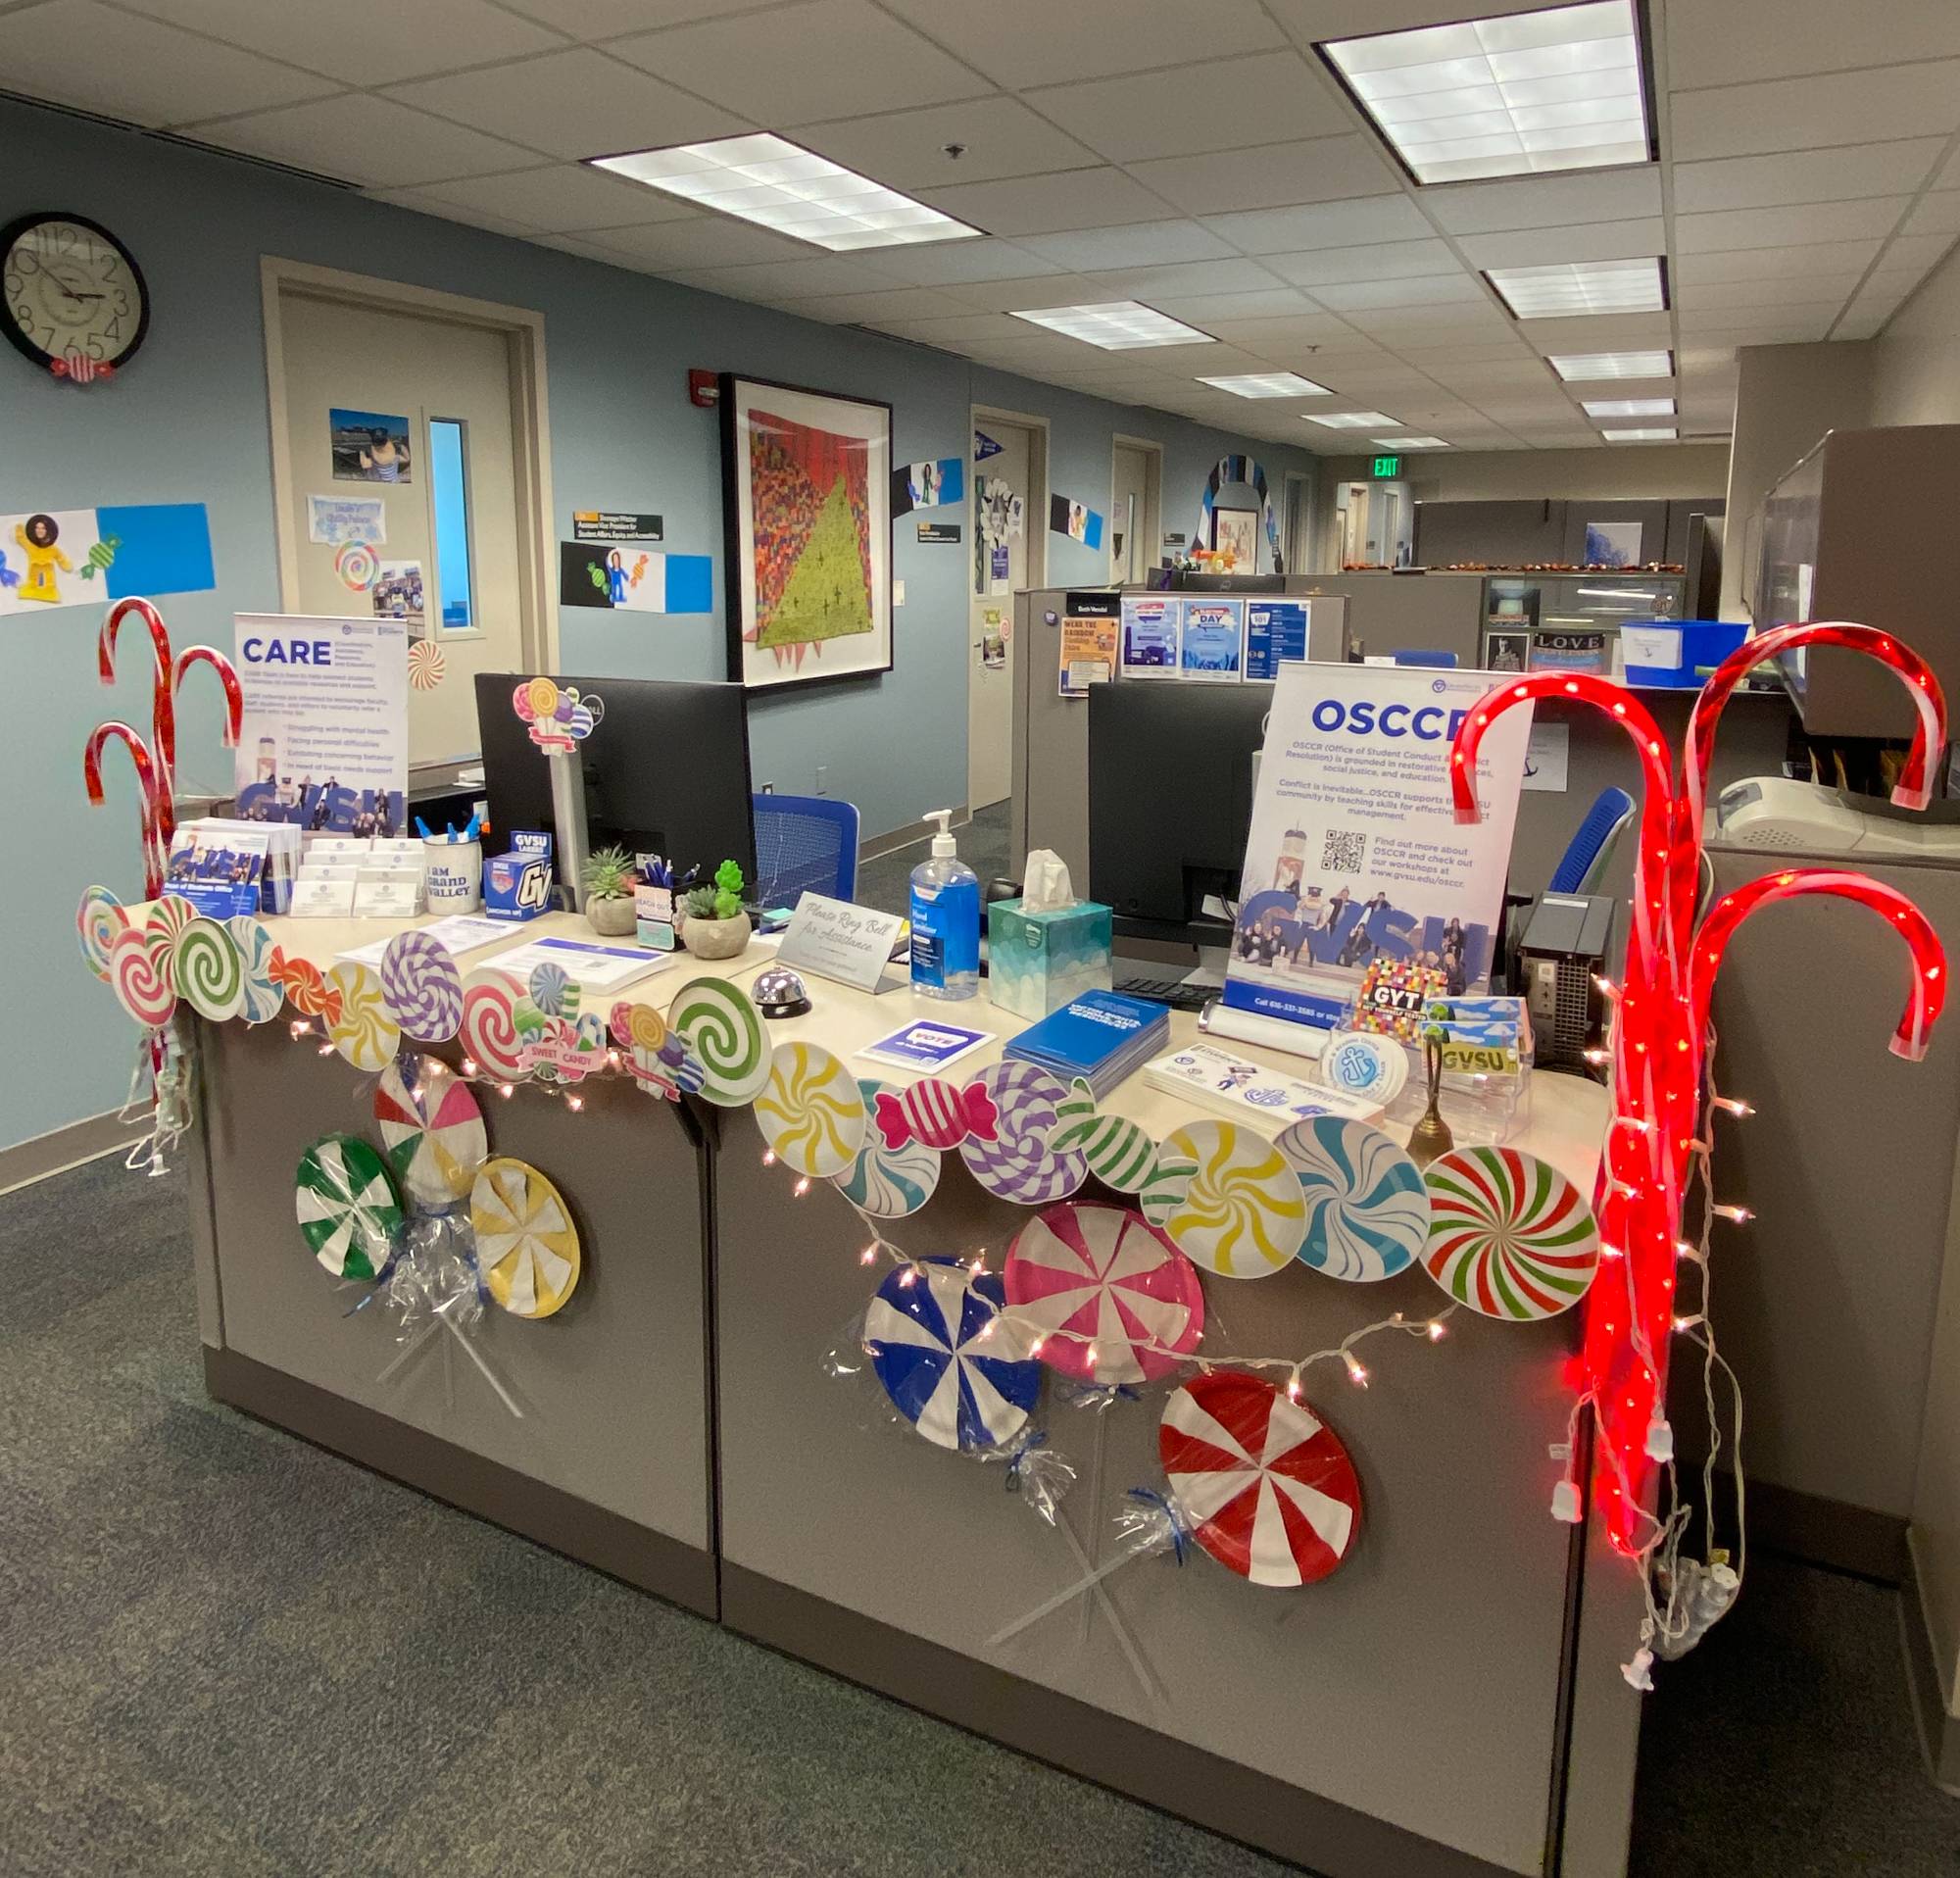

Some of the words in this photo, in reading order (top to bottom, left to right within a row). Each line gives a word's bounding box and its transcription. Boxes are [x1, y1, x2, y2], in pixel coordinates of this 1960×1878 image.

[54, 226, 77, 259] 12
[87, 238, 94, 266] 1
[101, 254, 118, 283] 2
[4, 273, 24, 302] 9
[114, 289, 128, 318] 3
[18, 305, 34, 334] 8
[104, 316, 120, 343] 4
[40, 326, 56, 351] 7
[87, 332, 105, 361] 5
[1374, 458, 1398, 476] EXIT
[1200, 615, 1223, 623] DAY
[243, 638, 331, 666] CARE
[1286, 750, 1333, 762] Resolution)
[1344, 757, 1386, 767] grounded
[1398, 762, 1446, 772] restorative
[1293, 741, 1323, 750] OSCCR
[1325, 744, 1353, 754] (Office
[1356, 746, 1365, 755] of
[1367, 748, 1401, 758] Student
[1403, 751, 1442, 762] Conduct
[1323, 765, 1348, 773] social
[1348, 767, 1379, 777] justice,
[1276, 790, 1323, 802] community
[1337, 796, 1374, 808] teaching
[1376, 800, 1397, 810] skills
[1279, 778, 1311, 789] Conflict
[1403, 794, 1443, 804] supports
[1348, 808, 1406, 820] management.
[515, 835, 547, 847] GVSU
[1375, 836, 1396, 846] Find
[1397, 840, 1412, 849] out
[1414, 844, 1439, 853] more
[1441, 847, 1468, 856] about
[1374, 847, 1405, 859] OSCCR
[1408, 852, 1425, 861] and
[1428, 855, 1454, 865] check
[1389, 861, 1438, 874] workshops
[798, 921, 817, 937] for
[806, 902, 836, 922] Please
[838, 912, 862, 930] Ring
[865, 919, 893, 936] Bell
[1254, 997, 1268, 1007] Call
[1374, 986, 1419, 1010] GYT
[915, 1032, 956, 1045] VOTE
[531, 1048, 558, 1060] SWEET
[563, 1054, 592, 1065] CANDY
[1443, 1051, 1503, 1071] GVSU
